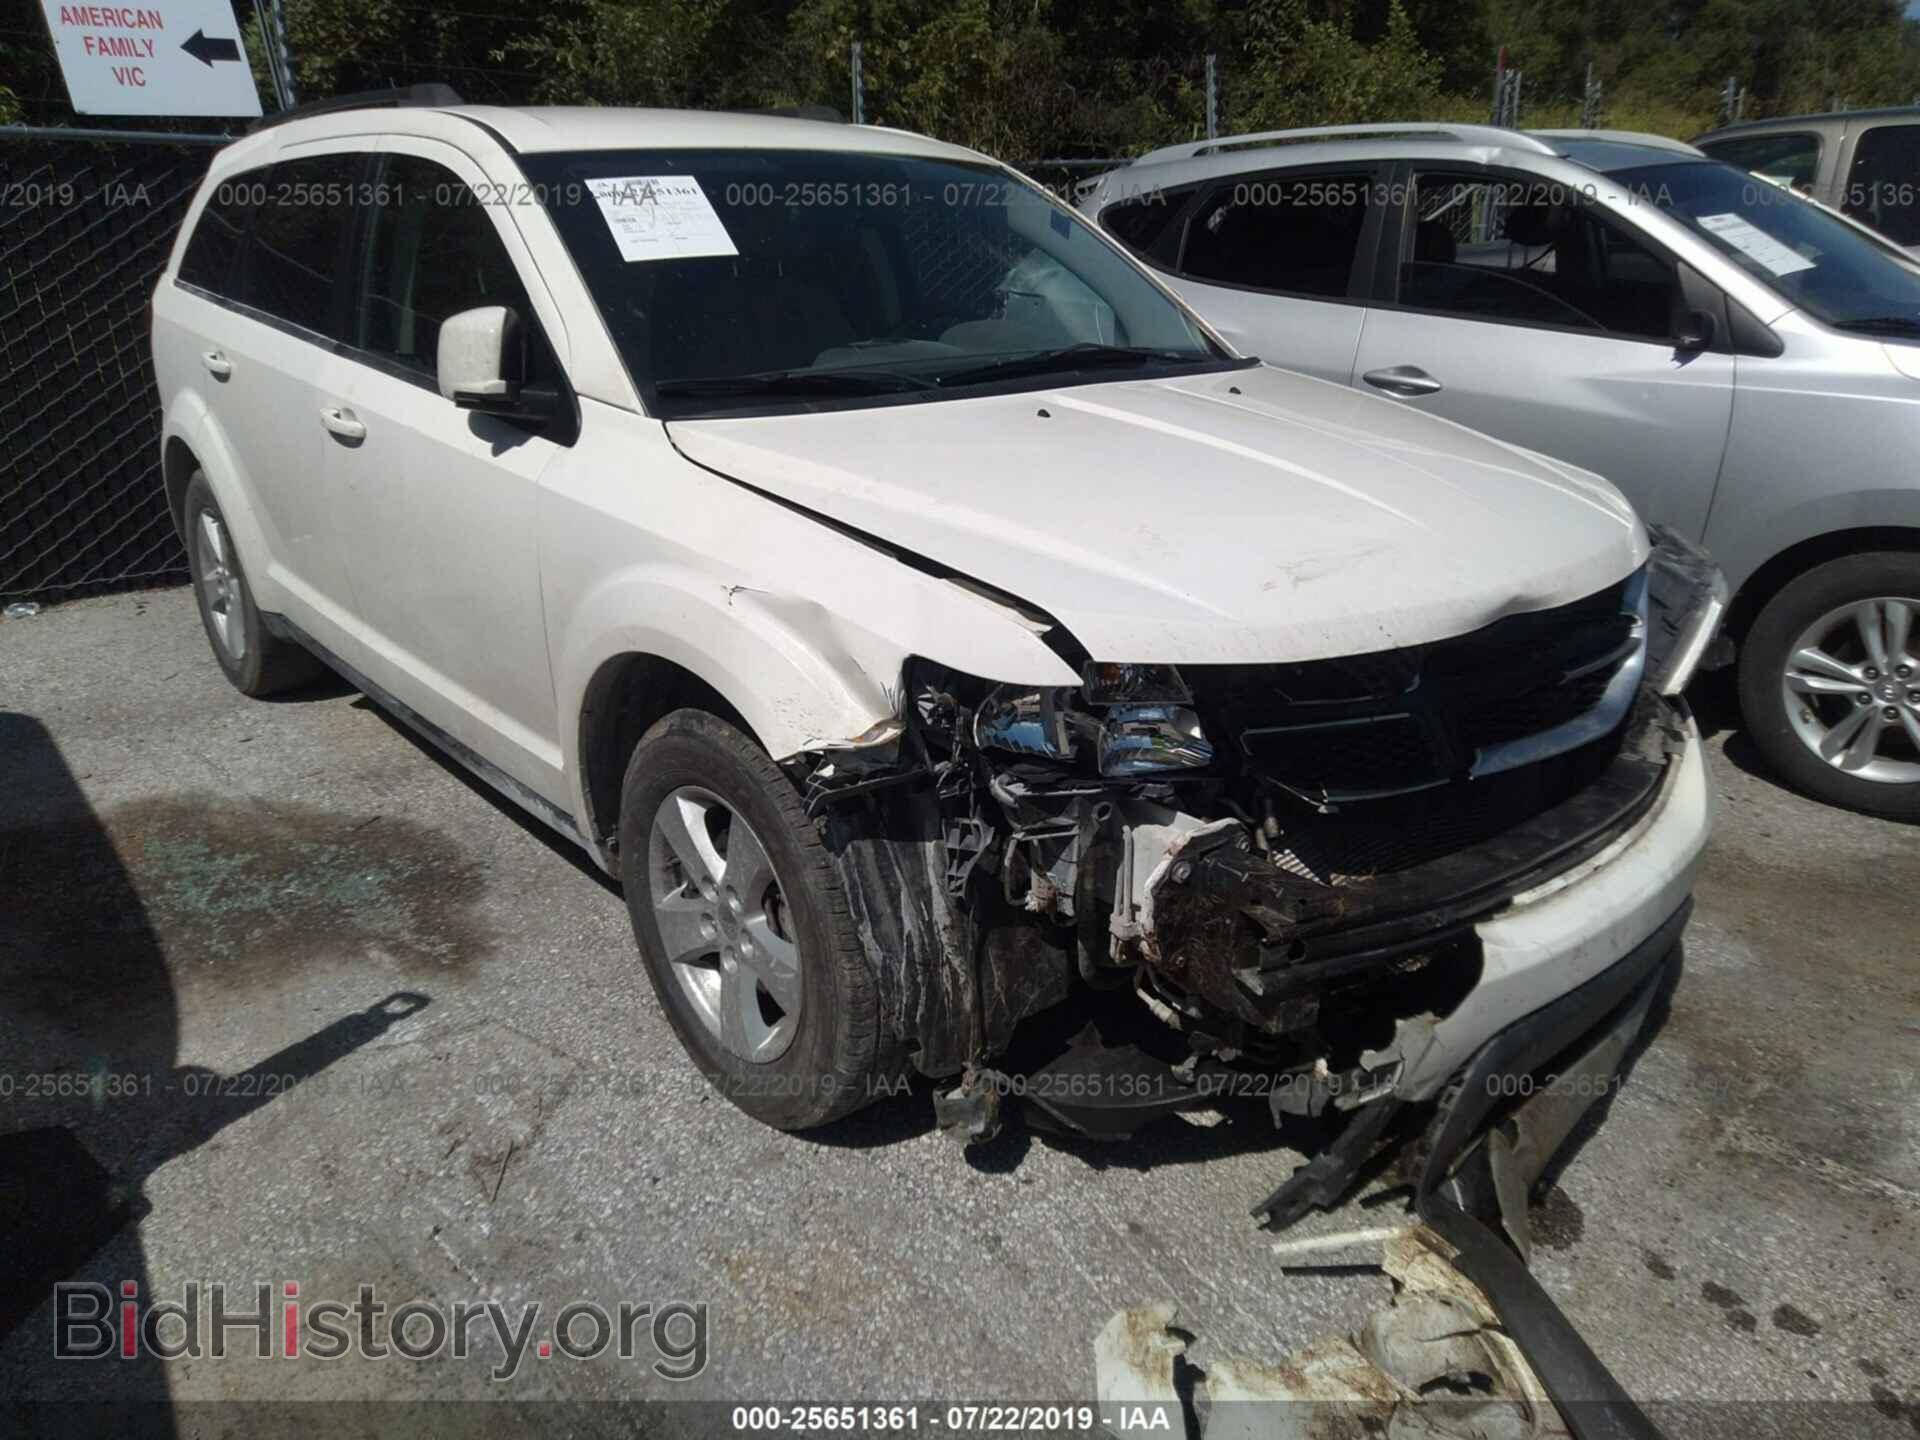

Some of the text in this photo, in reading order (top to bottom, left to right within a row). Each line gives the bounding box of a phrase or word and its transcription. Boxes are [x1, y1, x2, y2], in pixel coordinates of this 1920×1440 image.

[60, 5, 164, 30] AMERICAN
[83, 36, 154, 58] FAMILY
[112, 66, 146, 87] VIC
